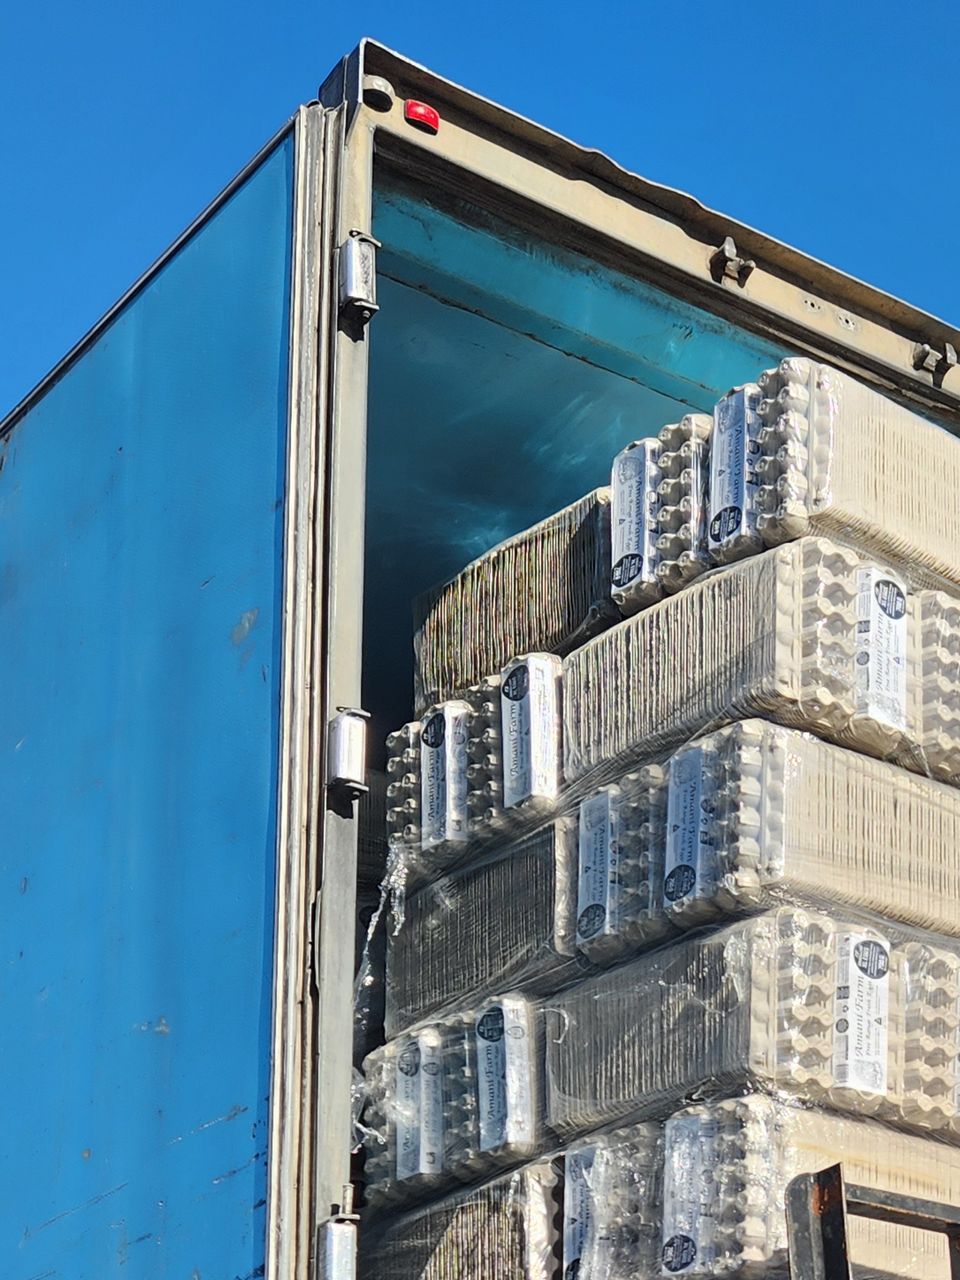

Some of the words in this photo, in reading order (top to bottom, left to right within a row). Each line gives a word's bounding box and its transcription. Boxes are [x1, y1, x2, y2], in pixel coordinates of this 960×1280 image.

[733, 424, 742, 464] Amani
[634, 474, 643, 513] Amani
[732, 470, 741, 503] Farm
[633, 518, 641, 551] Farm
[877, 613, 885, 646] Farm
[876, 651, 884, 692] Amani
[510, 739, 518, 777] Amani
[688, 781, 696, 823] Amani
[686, 828, 694, 863] Farm
[856, 976, 865, 1010] Farm
[854, 1015, 864, 1057] Amani
[485, 1046, 494, 1077] Farm
[486, 1082, 496, 1119] Amani
